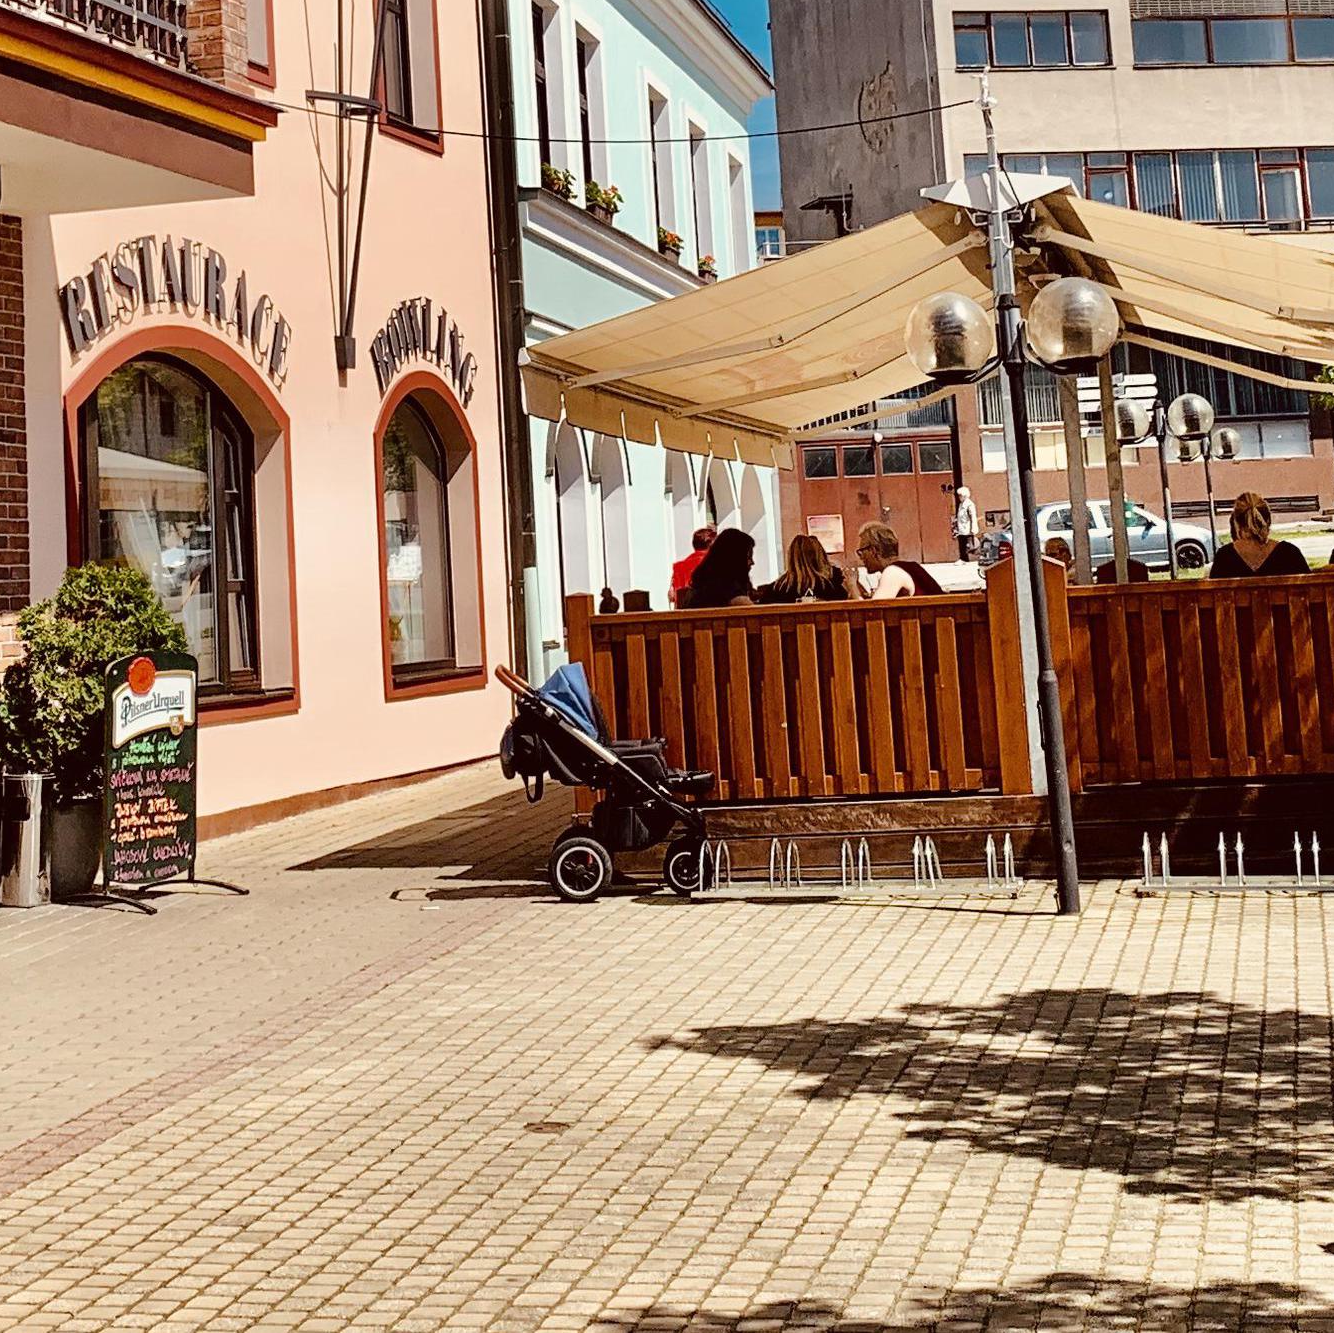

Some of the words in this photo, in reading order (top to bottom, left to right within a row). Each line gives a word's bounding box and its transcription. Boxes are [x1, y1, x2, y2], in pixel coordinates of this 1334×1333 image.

[59, 234, 292, 390] RESTAURACE
[369, 296, 477, 409] BOWLING
[120, 695, 153, 728] Pilsner
[152, 690, 185, 714] Urquell
